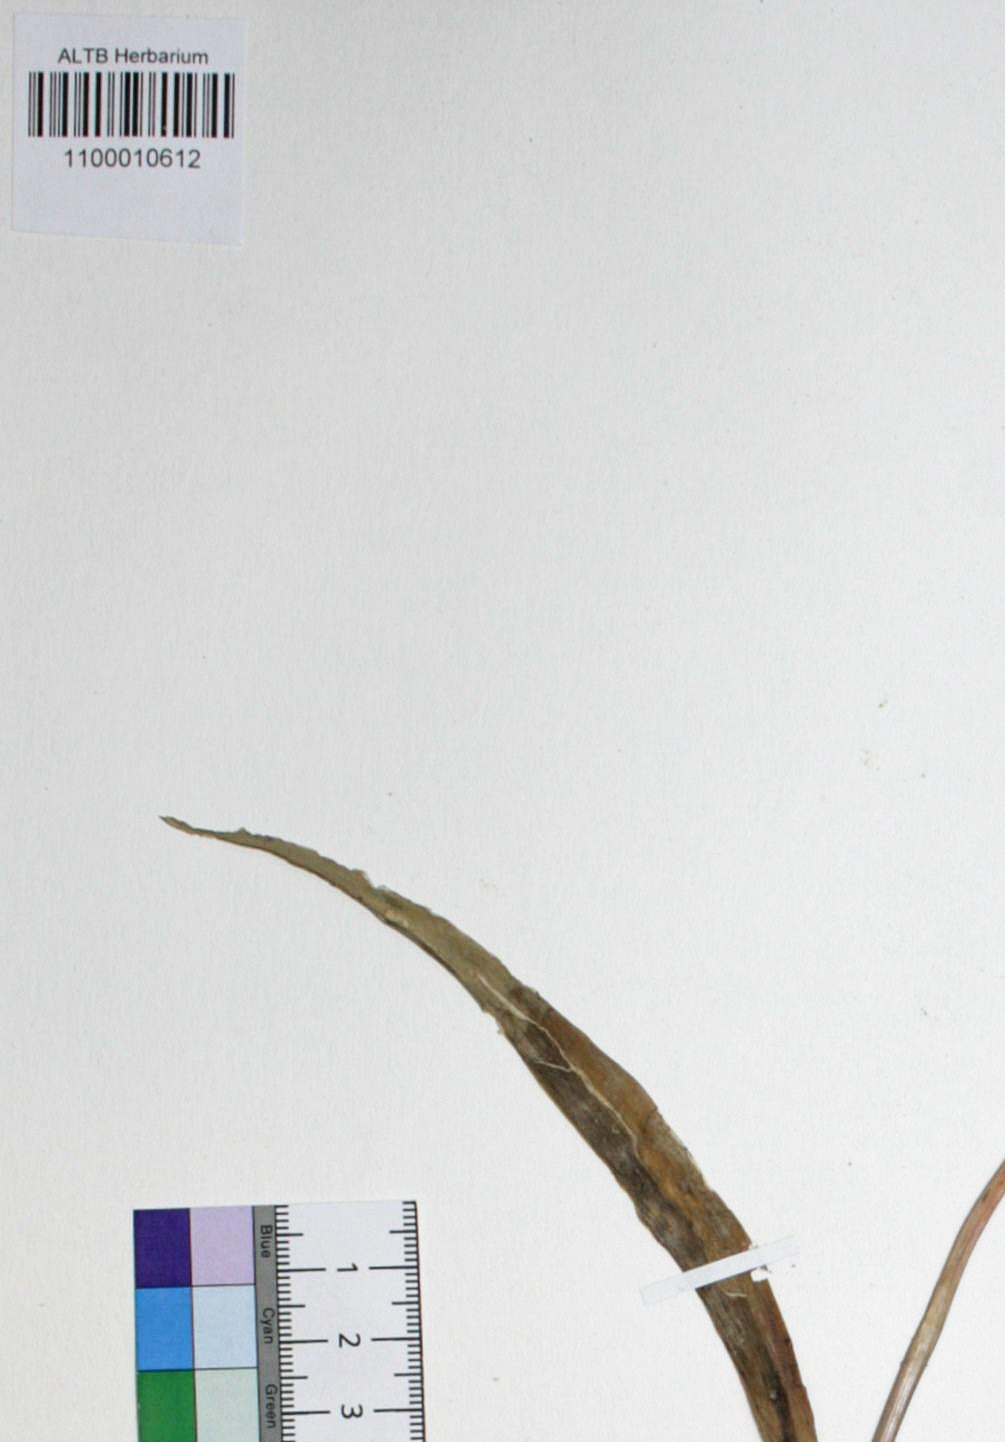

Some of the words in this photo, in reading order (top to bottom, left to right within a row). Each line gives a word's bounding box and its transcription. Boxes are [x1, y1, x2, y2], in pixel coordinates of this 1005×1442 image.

[57, 48, 108, 64] ALTB
[115, 48, 208, 64] Herbarium
[64, 148, 200, 169] 1100010612
[261, 1225, 272, 1258] Blue
[336, 1262, 359, 1272] 1
[260, 1307, 273, 1344] Cyan
[338, 1333, 361, 1348] 2
[267, 1384, 277, 1428] Green
[340, 1404, 363, 1419] 3
